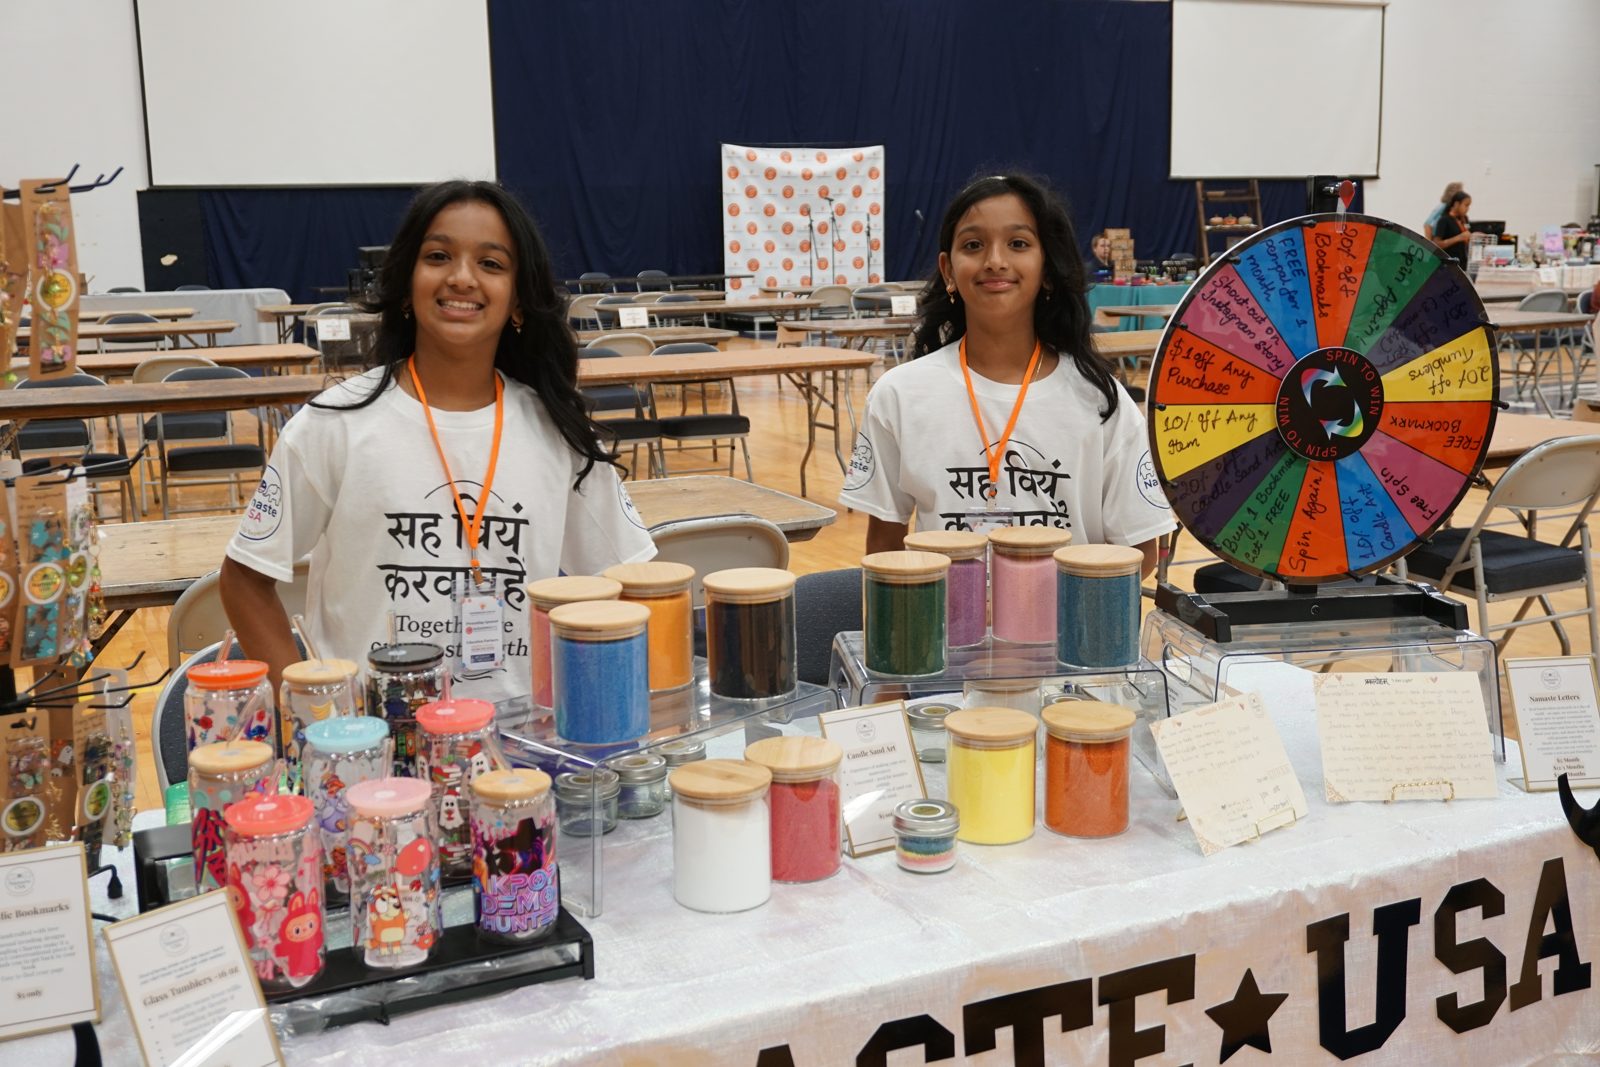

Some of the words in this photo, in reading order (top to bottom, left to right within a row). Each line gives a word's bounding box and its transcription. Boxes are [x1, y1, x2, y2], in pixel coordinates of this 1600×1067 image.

[1265, 238, 1292, 286] pen-pal
[1278, 237, 1306, 278] FREE
[1394, 244, 1425, 284] Spin
[1246, 253, 1273, 302] month
[1337, 266, 1358, 298] off
[1278, 287, 1300, 311] for
[1265, 326, 1280, 346] on
[1221, 360, 1256, 390] Any
[1408, 346, 1474, 382] Tumblers
[1458, 364, 1491, 390] 20%
[1167, 366, 1232, 397] Purchase
[1326, 350, 1359, 366] SPIN
[1360, 362, 1376, 381] TO
[1369, 385, 1381, 416] WIN
[1428, 375, 1451, 396] off
[1163, 410, 1194, 433] 10%
[1197, 408, 1222, 433] off
[1226, 410, 1258, 433] Any
[1278, 395, 1290, 427] WIN
[1389, 415, 1462, 433] BOOKMARK
[1286, 430, 1303, 449] TO
[1305, 443, 1337, 458] SPIN
[1442, 435, 1484, 451] FREE
[1301, 466, 1328, 521] Again!
[1357, 482, 1377, 508] Art
[1380, 466, 1410, 497] Spin
[248, 508, 263, 523] SA
[1265, 488, 1291, 526] FREE
[1409, 495, 1439, 521] Free
[384, 512, 444, 559] सह
[1220, 517, 1256, 555] Buy
[1247, 505, 1259, 520] 1
[1288, 530, 1319, 573] Spin
[395, 614, 463, 638] Togeth
[1529, 694, 1557, 703] Namaste
[1557, 694, 1581, 702] Letters
[846, 750, 870, 761] Candle
[870, 746, 885, 756] Sand
[885, 744, 897, 753] Art
[15, 902, 70, 920] Bookmarks
[1306, 857, 1593, 1062] USA
[142, 993, 168, 1007] Glass
[169, 976, 213, 997] Tumblers
